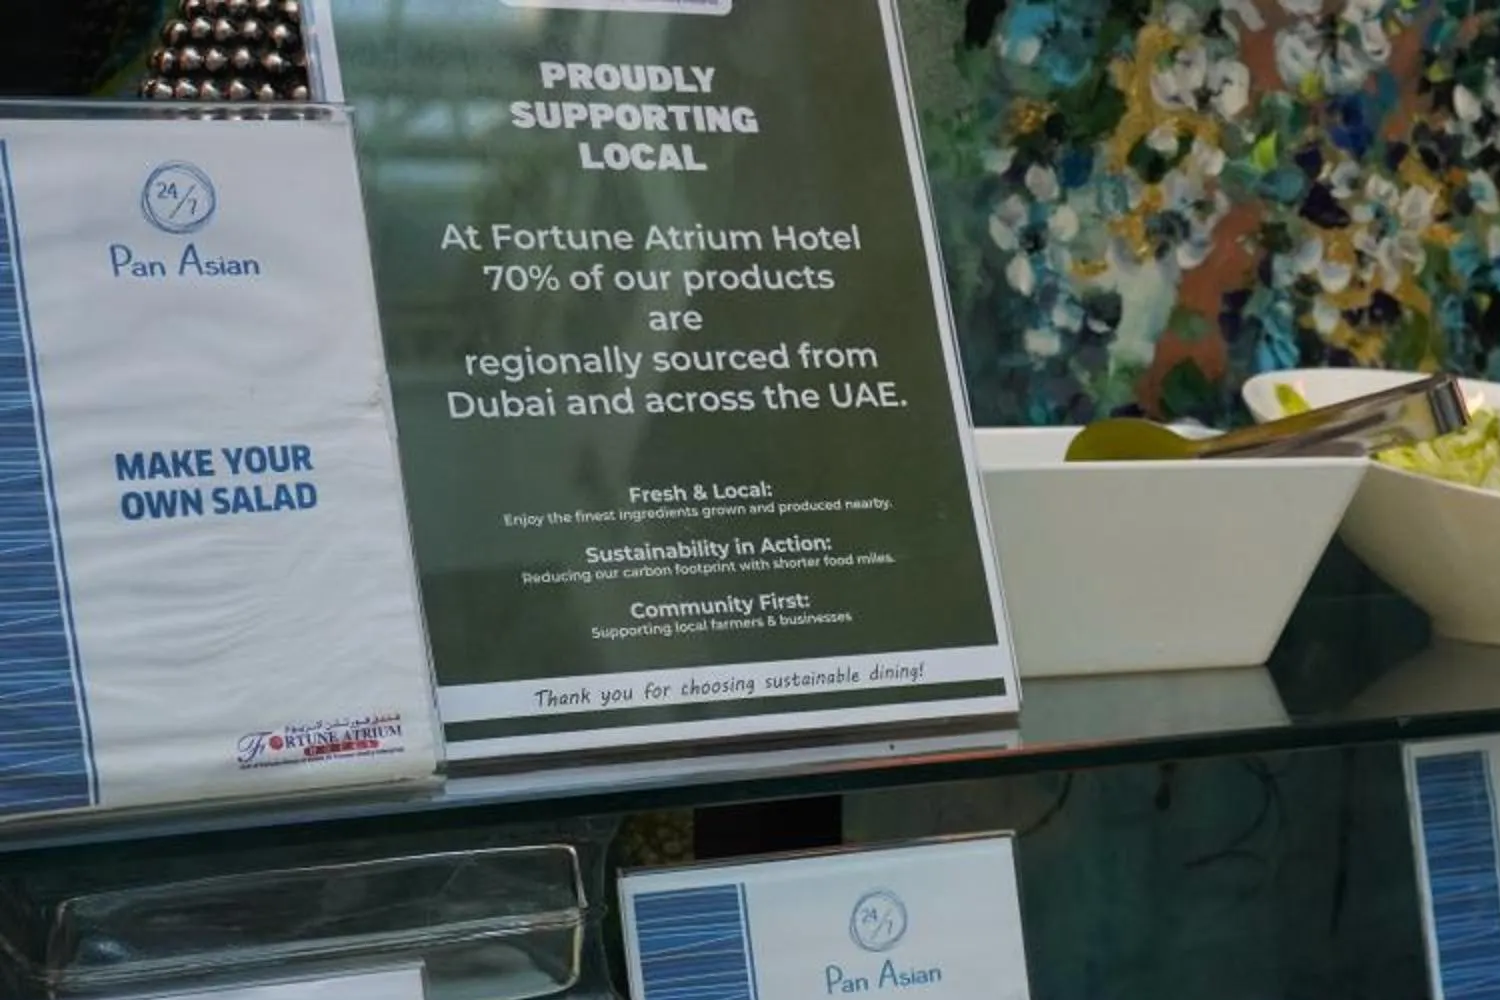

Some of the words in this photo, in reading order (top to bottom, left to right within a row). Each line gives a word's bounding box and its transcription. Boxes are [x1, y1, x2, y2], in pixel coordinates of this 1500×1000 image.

[539, 61, 716, 93] PROUDLY
[510, 101, 759, 133] SUPPORTING
[578, 142, 708, 171] LOCAL
[156, 182, 198, 219] 24/7
[441, 224, 483, 250] At
[491, 223, 634, 250] Fortune
[644, 224, 762, 250] Atrium
[771, 224, 862, 250] Hotel
[109, 243, 166, 277] Pan
[178, 242, 260, 276] Asian
[483, 265, 560, 291] 70%
[569, 264, 604, 291] of
[614, 270, 671, 291] our
[683, 264, 835, 296] products
[649, 310, 703, 331] are
[465, 345, 642, 382] regionally
[653, 342, 790, 372] sourced
[797, 342, 879, 369] from
[447, 387, 556, 419] Dubai
[566, 386, 635, 416] and
[645, 389, 755, 413] across
[762, 382, 820, 409] the
[829, 381, 908, 408] UAE.
[115, 448, 215, 480] MAKE
[222, 444, 314, 475] YOUR
[121, 488, 204, 520] OWN
[212, 482, 318, 515] SALAD
[629, 484, 687, 503] Fresh
[693, 484, 708, 500] &
[713, 480, 773, 499] Local:
[503, 513, 543, 528] Enjoy
[548, 511, 572, 524] the
[575, 509, 615, 523] finest
[619, 506, 699, 522] ingredients
[702, 504, 746, 518] grown
[749, 501, 774, 514] and
[778, 499, 842, 516] produced
[845, 497, 893, 511] nearby.
[585, 538, 730, 563] Sustainability
[734, 537, 755, 555] in
[761, 535, 833, 553] Action:
[522, 569, 591, 584] Reducing
[595, 569, 618, 580] our
[623, 565, 672, 579] carbon
[675, 560, 736, 576] footprint
[739, 558, 770, 572] with
[773, 556, 820, 570] shorter
[823, 553, 853, 567] food
[857, 551, 896, 565] miles.
[630, 595, 754, 619] Community
[759, 592, 811, 611] First:
[592, 620, 672, 640] Supporting
[675, 617, 707, 633] local
[711, 615, 765, 631] farmers
[780, 611, 853, 626] businesses
[534, 687, 590, 708] Thank
[601, 687, 634, 706] you
[644, 681, 671, 699] for
[681, 677, 755, 695] choosing
[765, 665, 860, 689] sustainable
[869, 661, 925, 682] dining!
[825, 964, 869, 994] Pan
[878, 959, 942, 989] Asian
